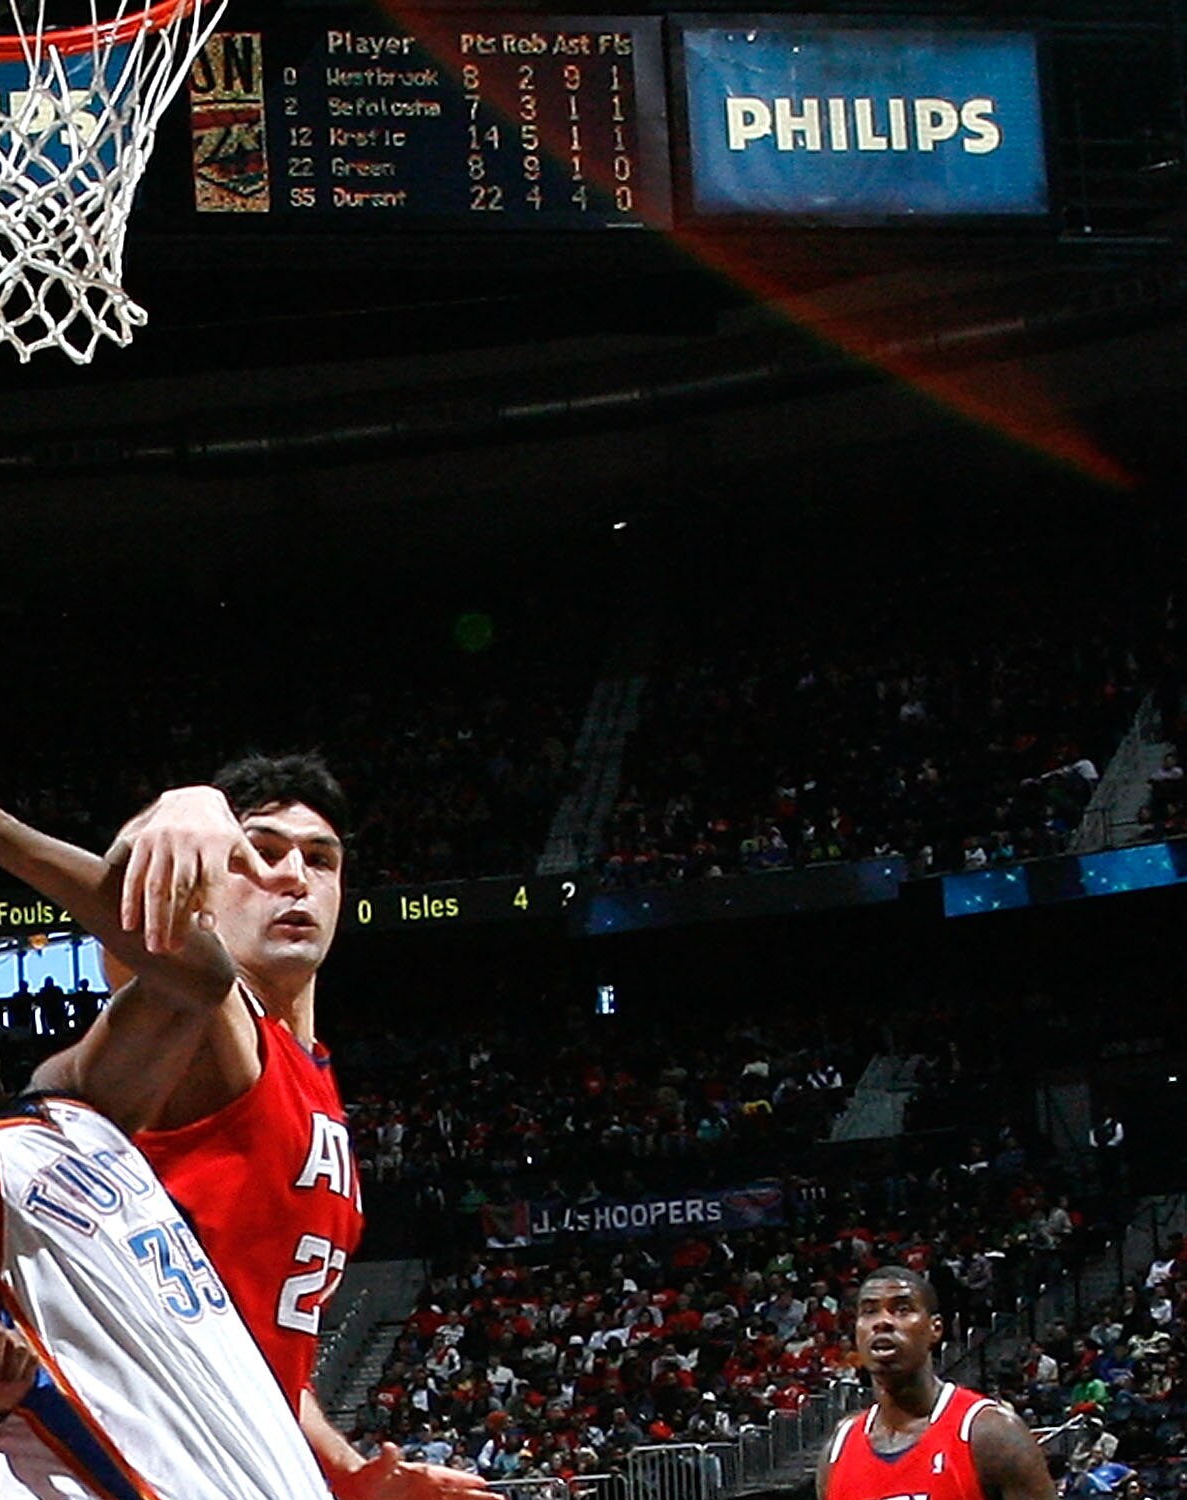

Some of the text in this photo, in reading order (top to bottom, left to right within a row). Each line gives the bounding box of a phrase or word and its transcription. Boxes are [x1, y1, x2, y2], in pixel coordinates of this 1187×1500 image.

[326, 29, 632, 60] Player Pts Reb Ast Fls
[282, 66, 298, 87] 0
[463, 64, 480, 89] 8
[518, 64, 535, 90] 2
[564, 65, 581, 90] 9
[610, 65, 623, 90] 1
[283, 96, 300, 117] 2
[464, 94, 481, 120] 7
[520, 94, 537, 121] 3
[569, 95, 580, 120] 1
[612, 95, 625, 121] 1
[288, 125, 314, 147] 12
[467, 125, 500, 150] 14
[520, 125, 539, 150] 5
[570, 125, 582, 150] 1
[613, 125, 625, 150] 1
[727, 97, 1001, 154] PHILIPS
[286, 157, 314, 178] 22
[468, 154, 486, 180] 8
[571, 155, 583, 180] 1
[614, 156, 630, 181] 0
[470, 185, 504, 211] 22
[525, 185, 542, 211] 4
[571, 185, 587, 211] 4
[615, 186, 632, 211] 0
[357, 900, 372, 924] 0
[400, 894, 460, 920] Isles
[513, 886, 529, 910] 4
[295, 1112, 363, 1214] AT
[593, 1198, 723, 1231] HOOPERS
